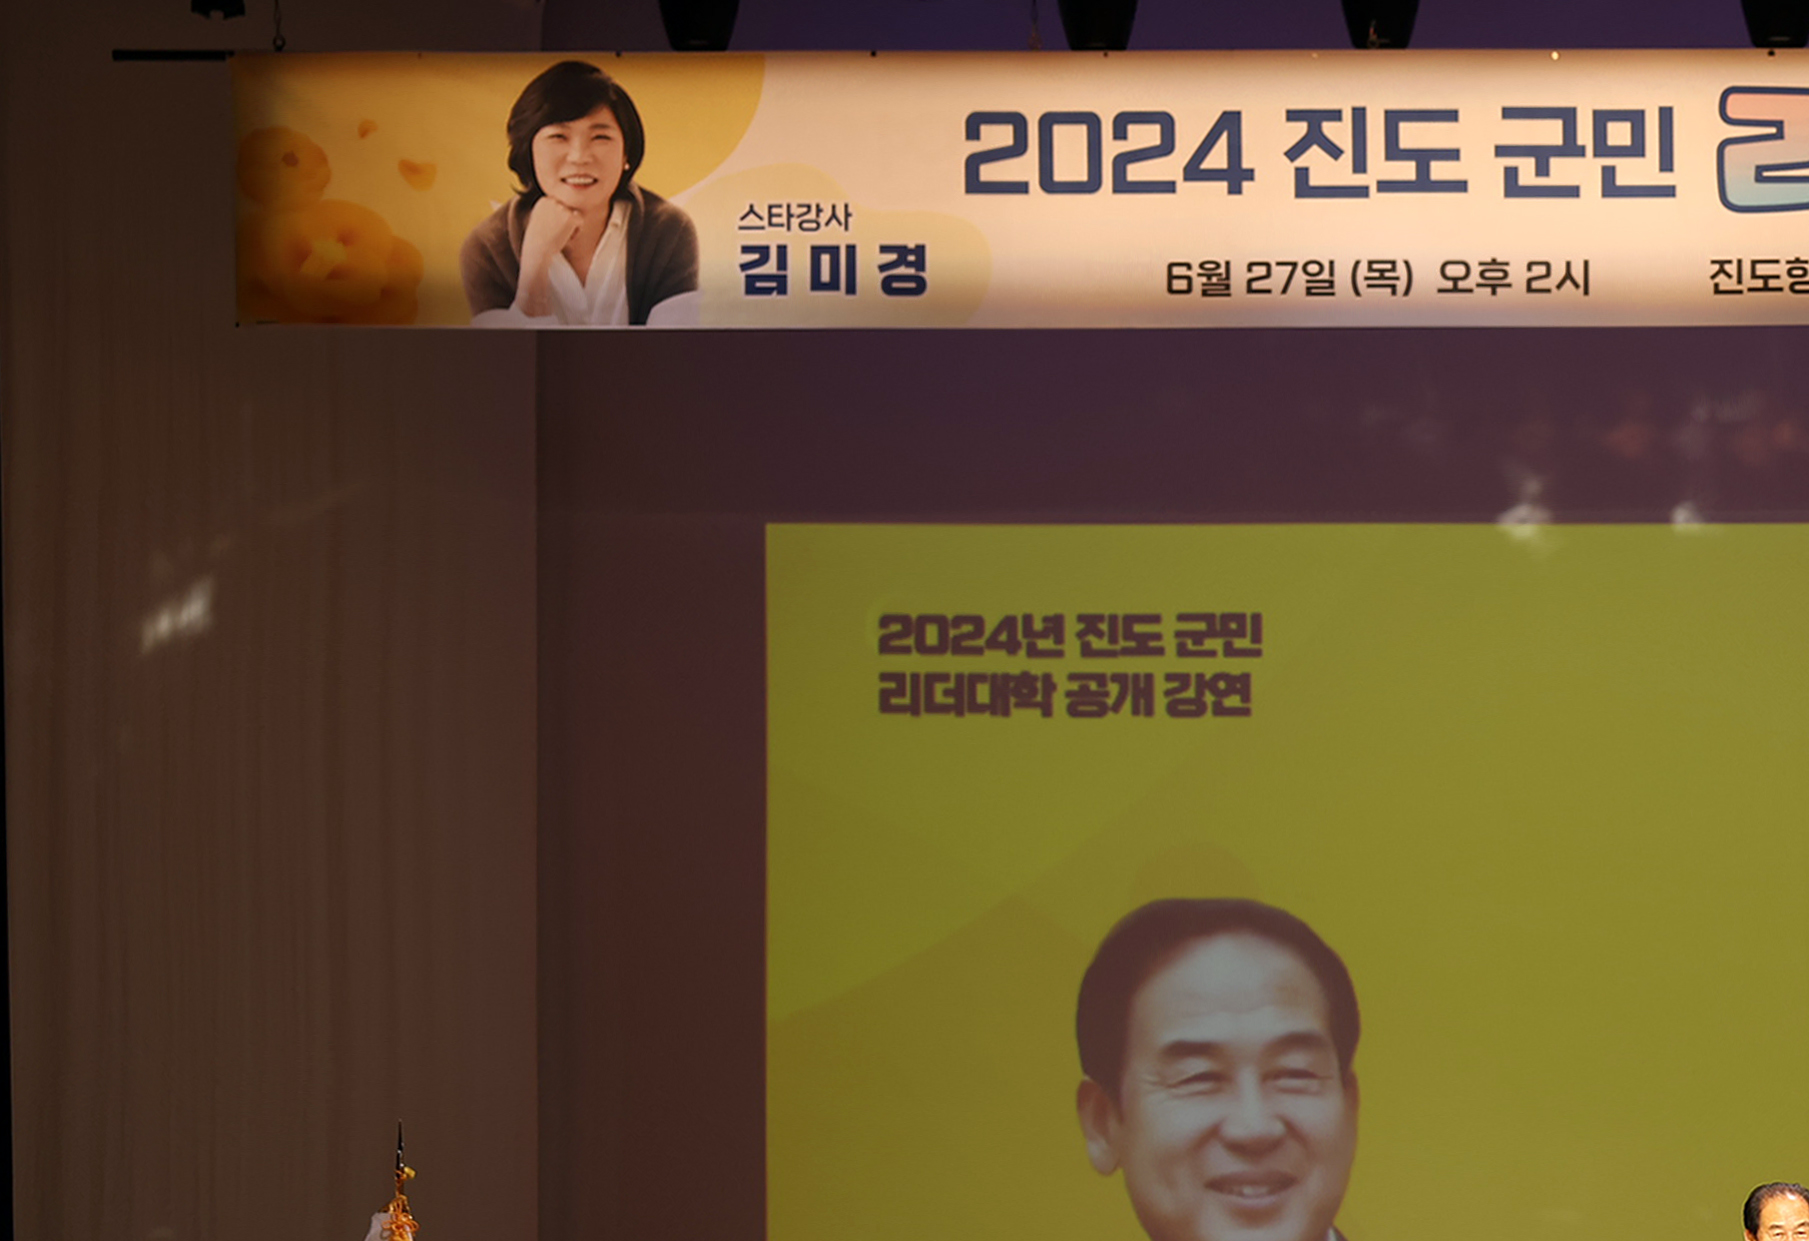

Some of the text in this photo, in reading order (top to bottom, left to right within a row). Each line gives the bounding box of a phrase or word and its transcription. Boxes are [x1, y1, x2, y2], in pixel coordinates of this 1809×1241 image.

[964, 110, 1255, 195] 2024
[1283, 106, 1469, 199] 진도
[1494, 106, 1678, 199] 군민
[738, 203, 853, 233] 스타강사
[738, 243, 929, 296] 김미경
[1166, 258, 1591, 298] 6월 27일 (목) 오후 2시
[878, 612, 1264, 659] 2024년 진도 군민
[877, 671, 1252, 718] 리더대학 공개 강연
